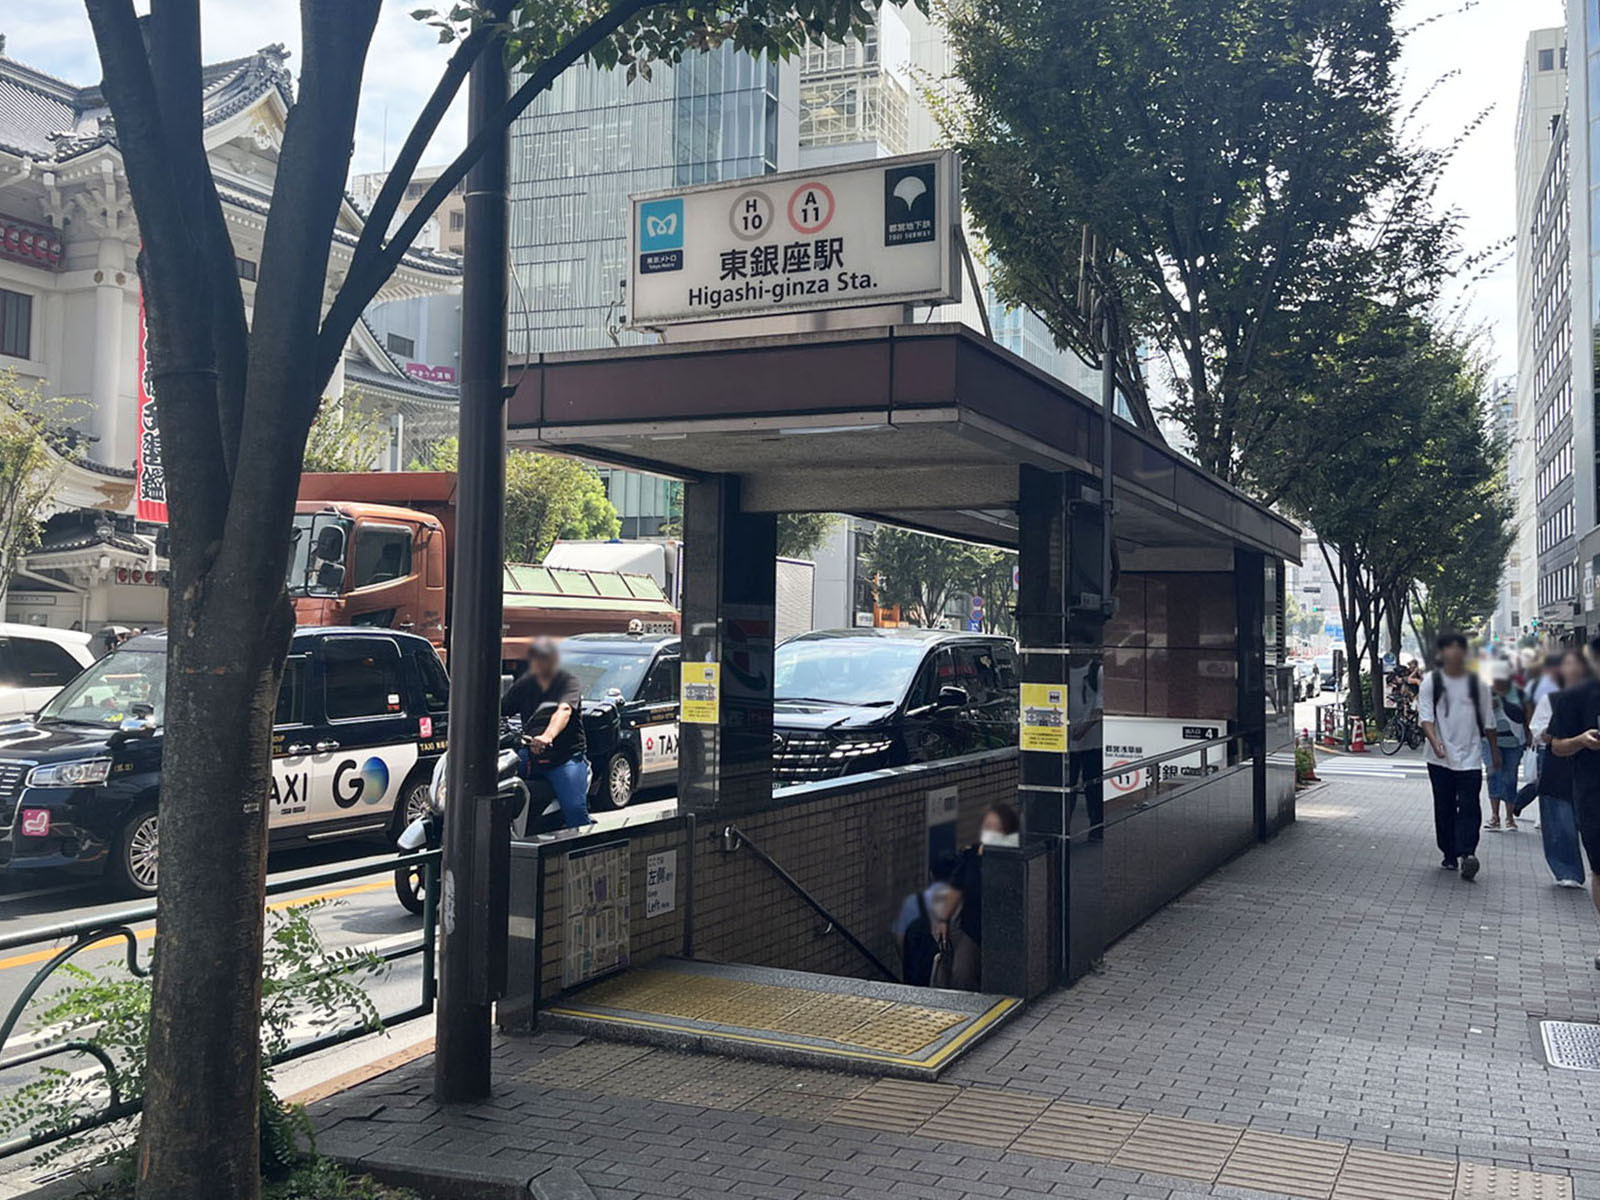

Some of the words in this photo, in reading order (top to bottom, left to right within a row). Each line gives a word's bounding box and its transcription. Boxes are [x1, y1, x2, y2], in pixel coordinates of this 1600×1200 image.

[746, 199, 757, 213] H
[805, 191, 817, 206] A
[742, 214, 763, 231] 10
[802, 207, 819, 223] 11
[720, 237, 844, 281] 東銀座駅
[689, 278, 829, 309] Higashi-ginza
[837, 272, 878, 292] Sta.
[1204, 728, 1214, 740] 4
[659, 734, 680, 755] TAX
[270, 772, 308, 805] AXI
[332, 756, 390, 809] GO
